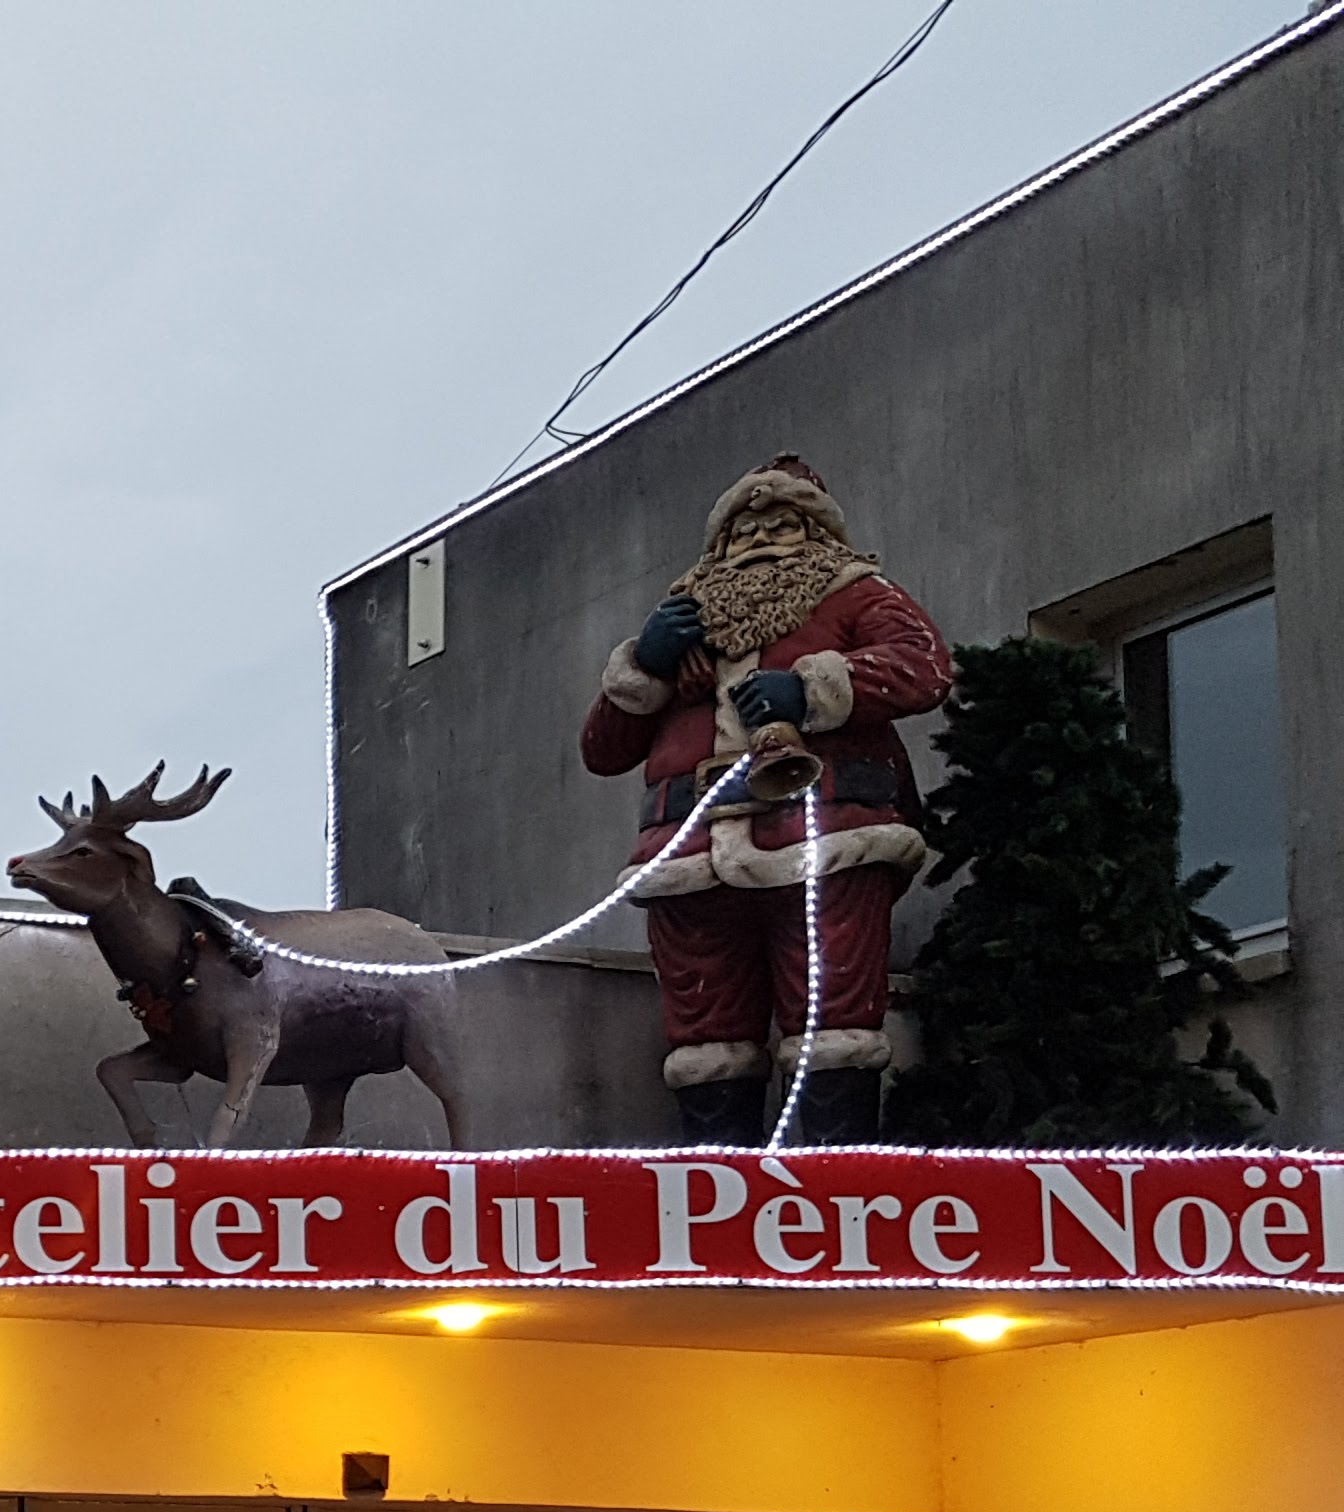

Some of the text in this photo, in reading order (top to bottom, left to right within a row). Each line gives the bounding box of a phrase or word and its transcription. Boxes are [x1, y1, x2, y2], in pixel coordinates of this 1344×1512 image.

[396, 1163, 597, 1274] du
[642, 1156, 980, 1274] Père
[1026, 1163, 1344, 1276] Noël
